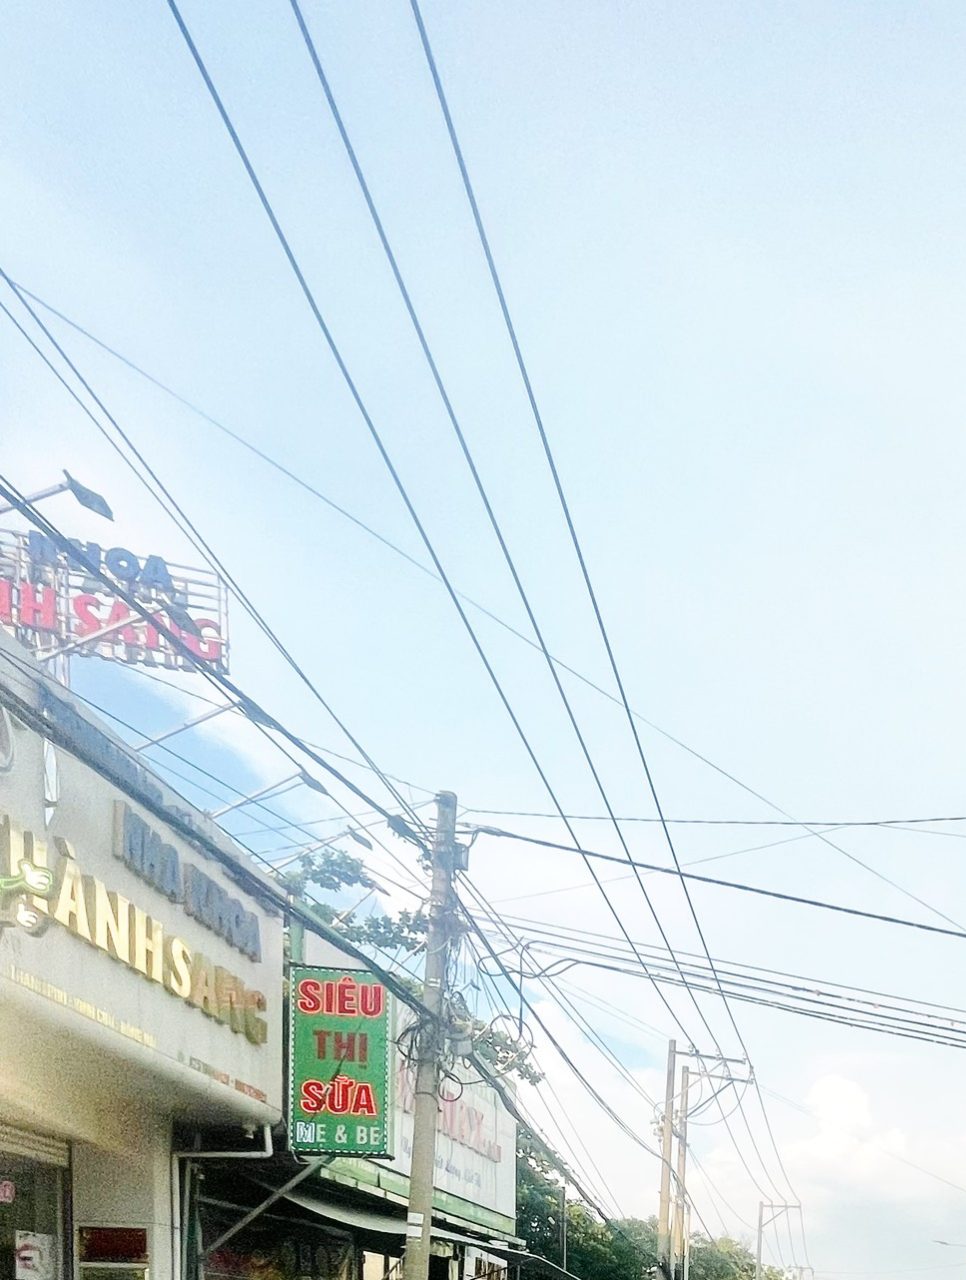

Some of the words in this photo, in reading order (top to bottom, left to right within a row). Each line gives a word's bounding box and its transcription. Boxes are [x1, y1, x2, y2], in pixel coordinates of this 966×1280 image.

[297, 977, 384, 1018] SIÊU
[313, 1029, 368, 1070] THỊ
[301, 1075, 377, 1116] SỮA
[335, 1124, 347, 1143] &
